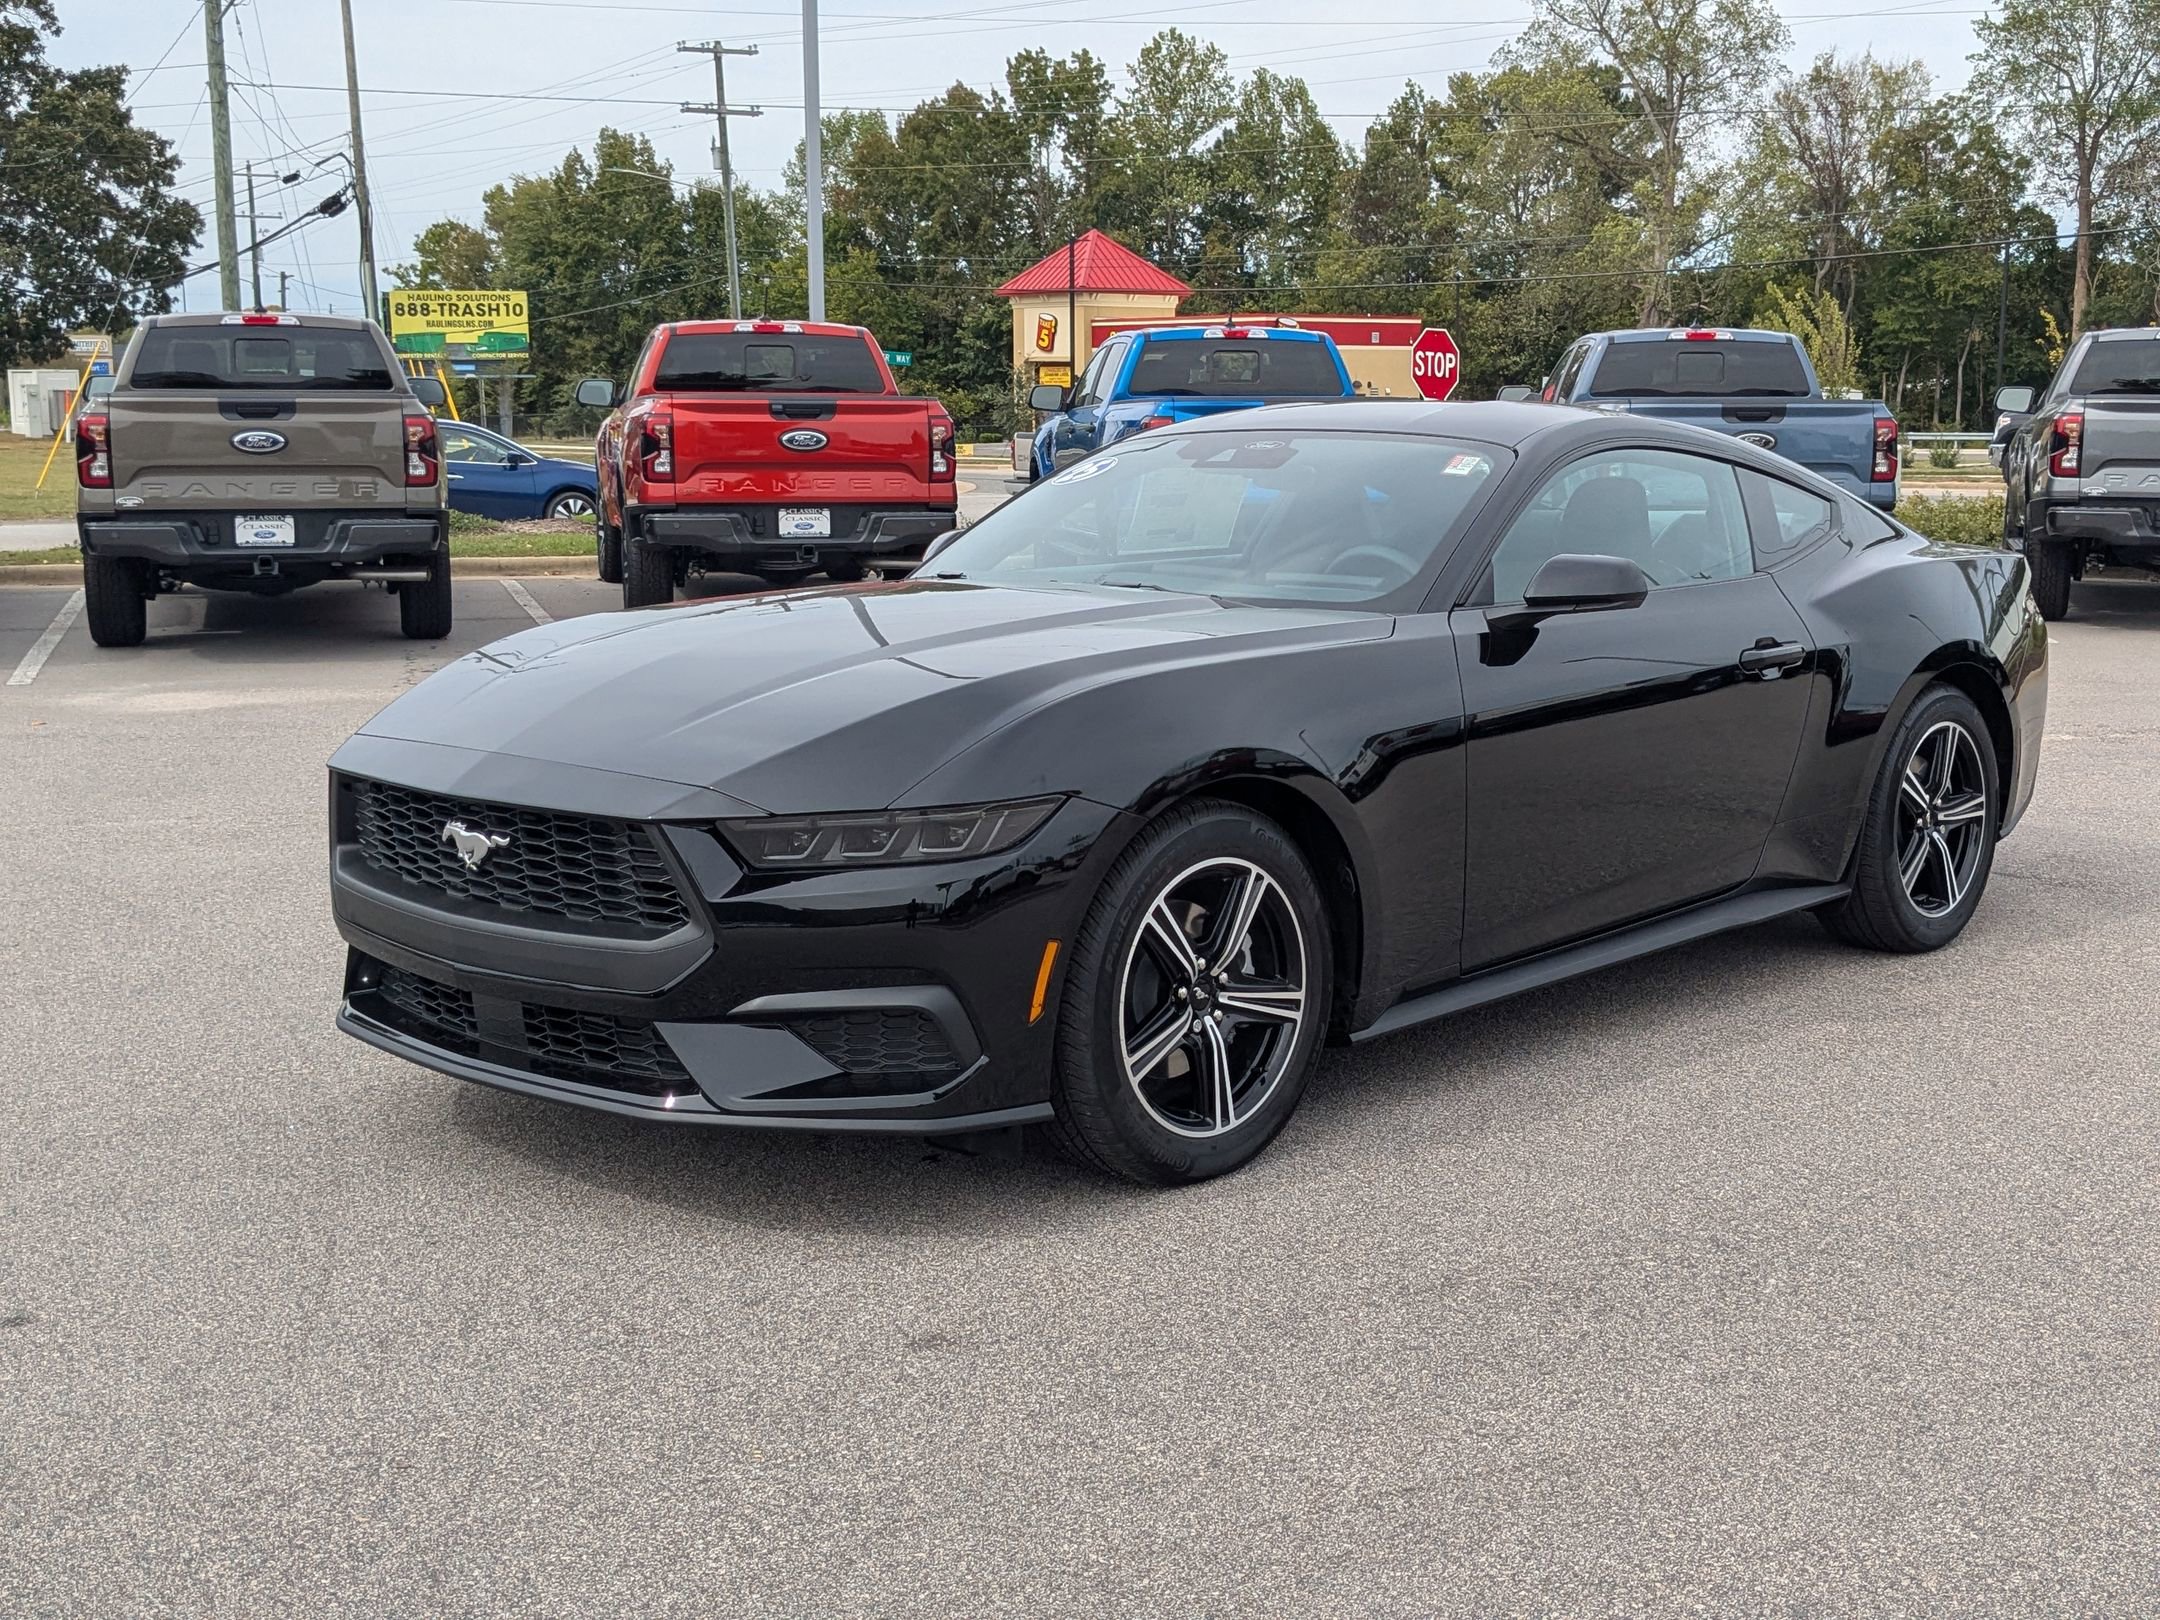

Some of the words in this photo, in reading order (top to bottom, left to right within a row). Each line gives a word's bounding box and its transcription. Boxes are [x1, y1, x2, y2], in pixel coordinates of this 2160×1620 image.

[407, 294, 453, 302] HAULING
[456, 294, 511, 302] SOLUTIONS
[394, 302, 524, 317] 888-TRASH10
[426, 320, 494, 329] HAULINGSLNS.COM
[1038, 328, 1049, 348] 5
[896, 354, 911, 363] WAY
[1414, 350, 1456, 378] STOP
[246, 436, 274, 447] Ford
[140, 482, 381, 498] RANGER
[699, 478, 909, 493] RANGER
